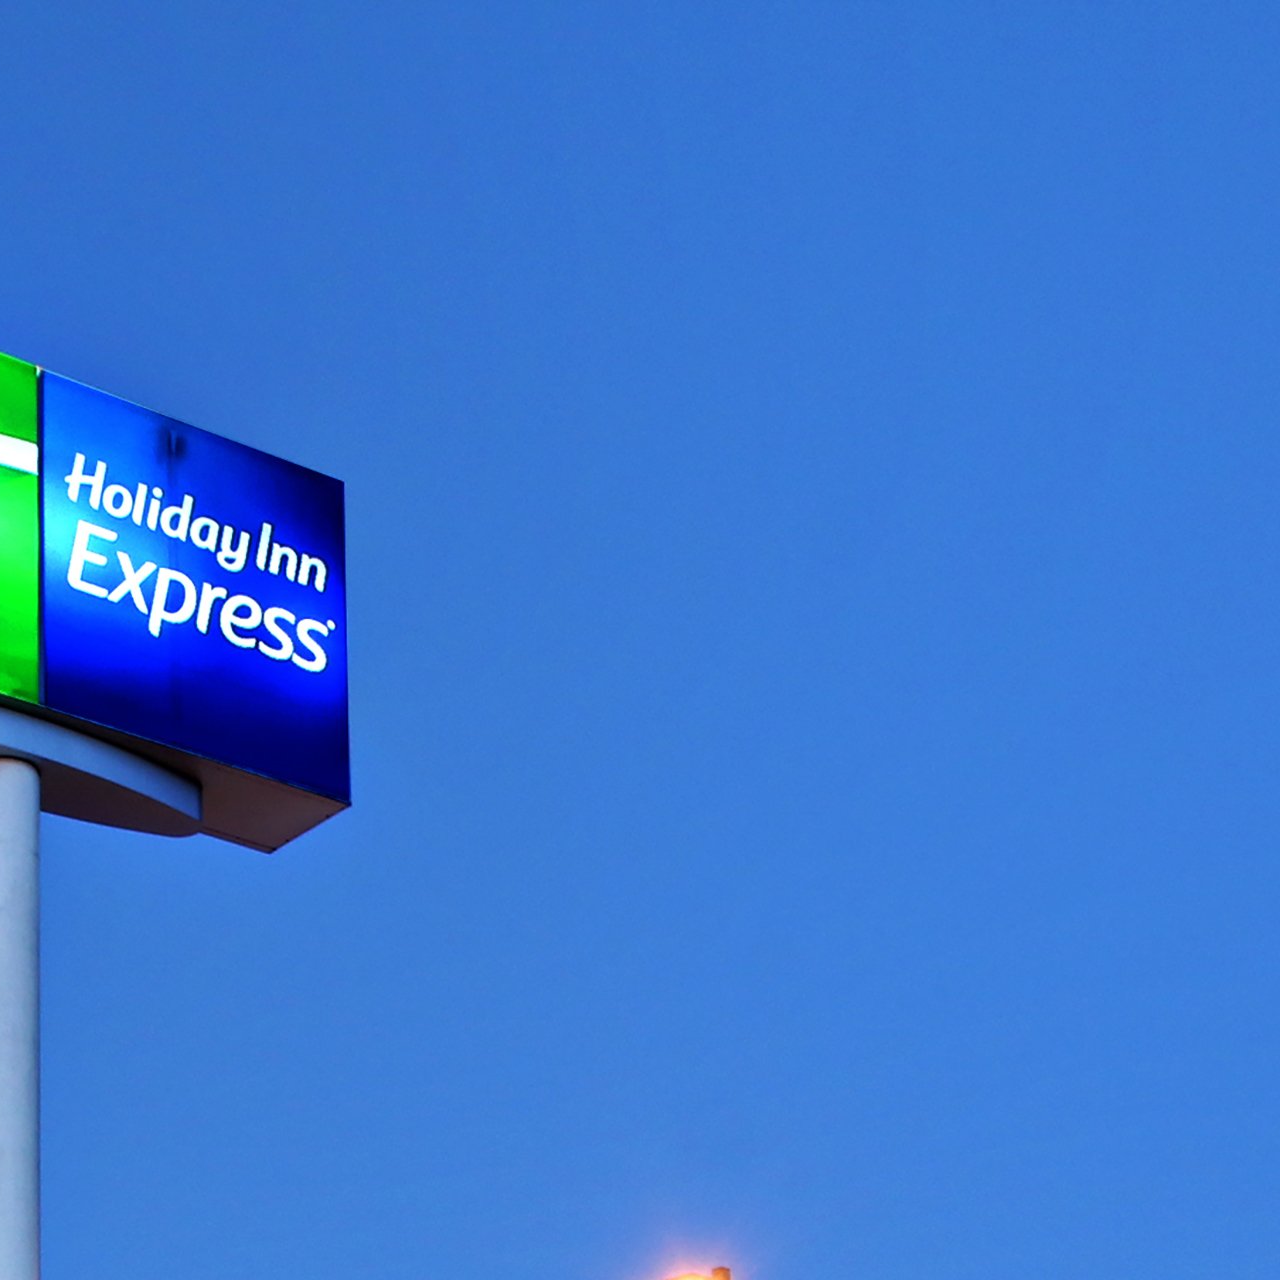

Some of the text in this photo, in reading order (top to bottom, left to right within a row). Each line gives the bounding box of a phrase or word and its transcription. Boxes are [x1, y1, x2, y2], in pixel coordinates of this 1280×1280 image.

[64, 452, 327, 593] Holiday Inn
[66, 519, 328, 673] Express
